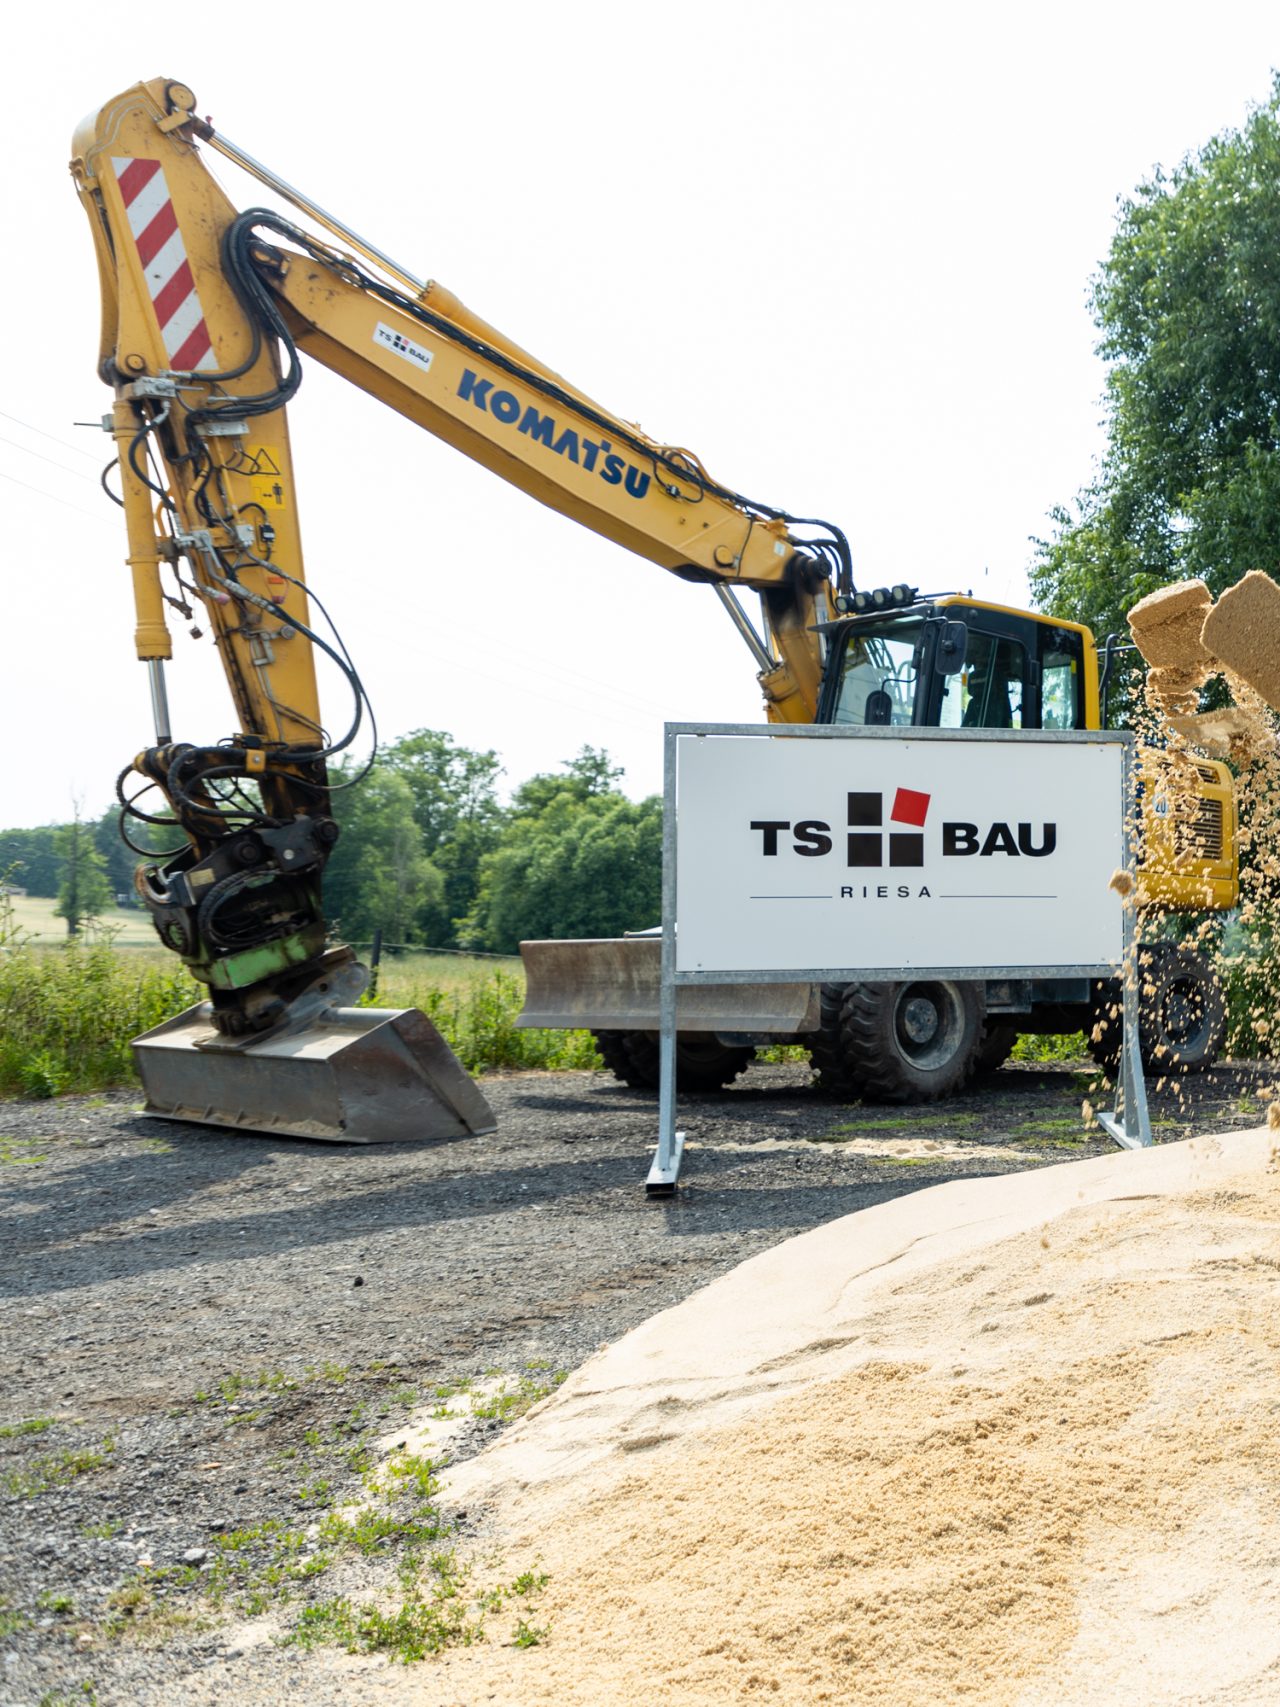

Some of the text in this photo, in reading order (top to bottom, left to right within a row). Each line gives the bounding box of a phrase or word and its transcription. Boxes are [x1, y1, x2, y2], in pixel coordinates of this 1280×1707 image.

[378, 329, 392, 341] TS
[409, 347, 430, 363] BAU
[456, 368, 652, 499] KOMATSU
[750, 820, 1057, 857] TS BAU
[840, 886, 931, 899] RIESA
